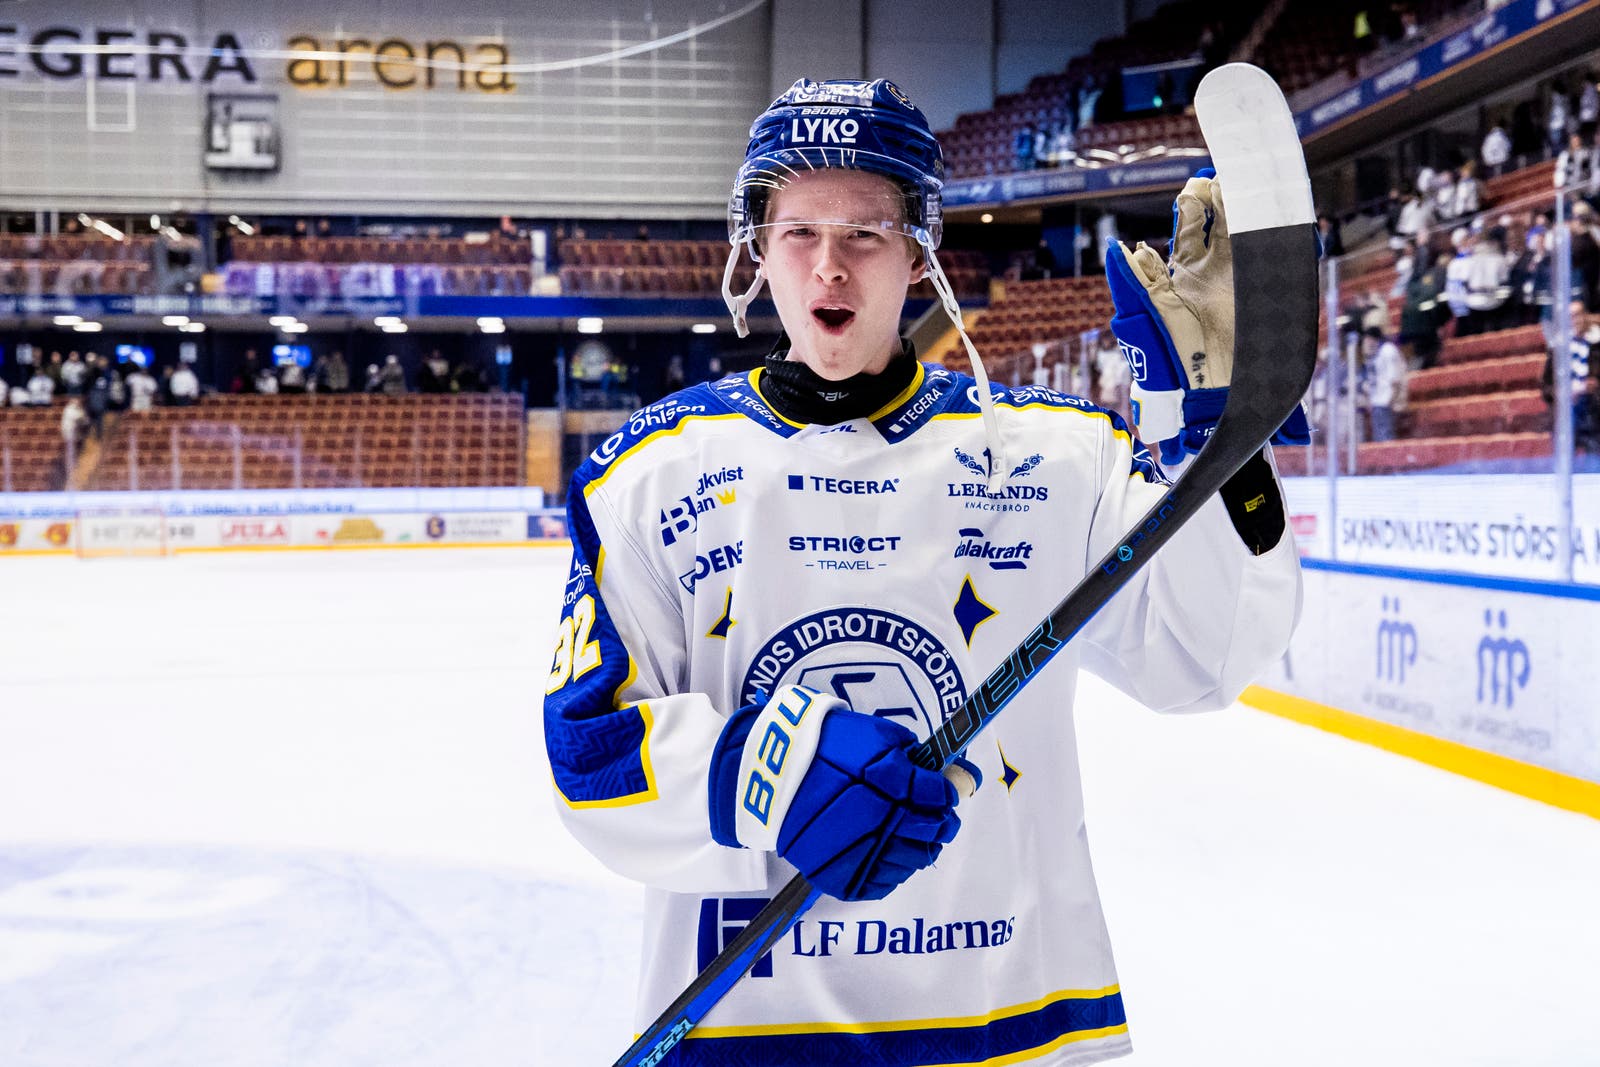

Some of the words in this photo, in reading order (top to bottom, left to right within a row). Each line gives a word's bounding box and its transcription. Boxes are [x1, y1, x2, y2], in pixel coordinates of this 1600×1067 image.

[287, 35, 517, 91] arena
[791, 118, 860, 144] LYKO
[630, 405, 706, 436] Ohlson
[899, 388, 943, 425] TEGERA
[222, 523, 287, 538] JULA
[1487, 513, 1588, 565] STÖRSA
[817, 560, 875, 570] TRAVEL
[545, 594, 602, 695] 32
[743, 685, 821, 830] BAU
[792, 919, 846, 957] LF
[854, 916, 1015, 955] Dalarnas
